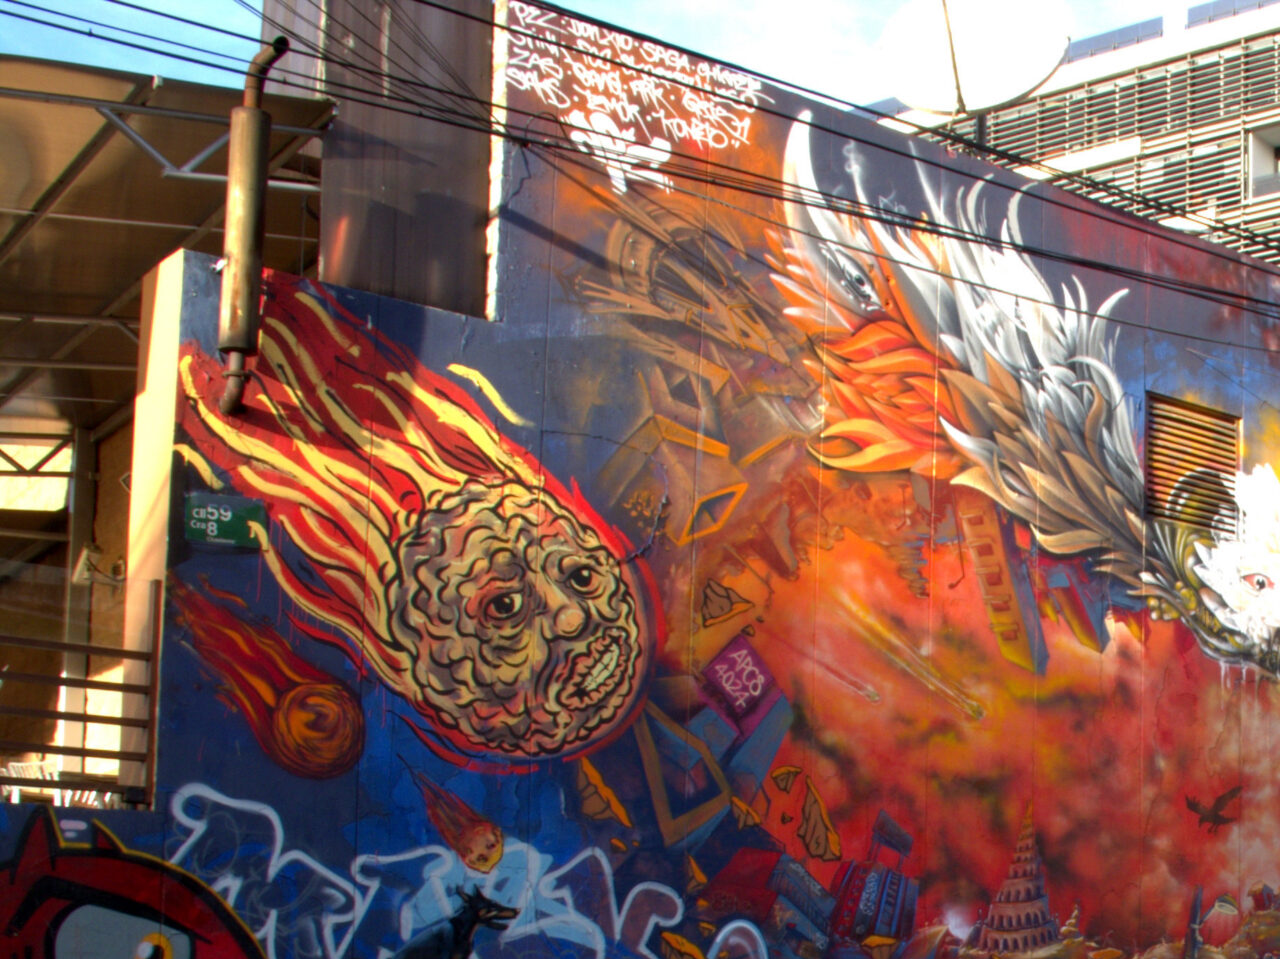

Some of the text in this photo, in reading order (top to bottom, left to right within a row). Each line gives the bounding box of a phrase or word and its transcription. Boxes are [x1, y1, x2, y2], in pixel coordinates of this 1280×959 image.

[207, 504, 232, 521] 59
[190, 519, 218, 536] Cra 8
